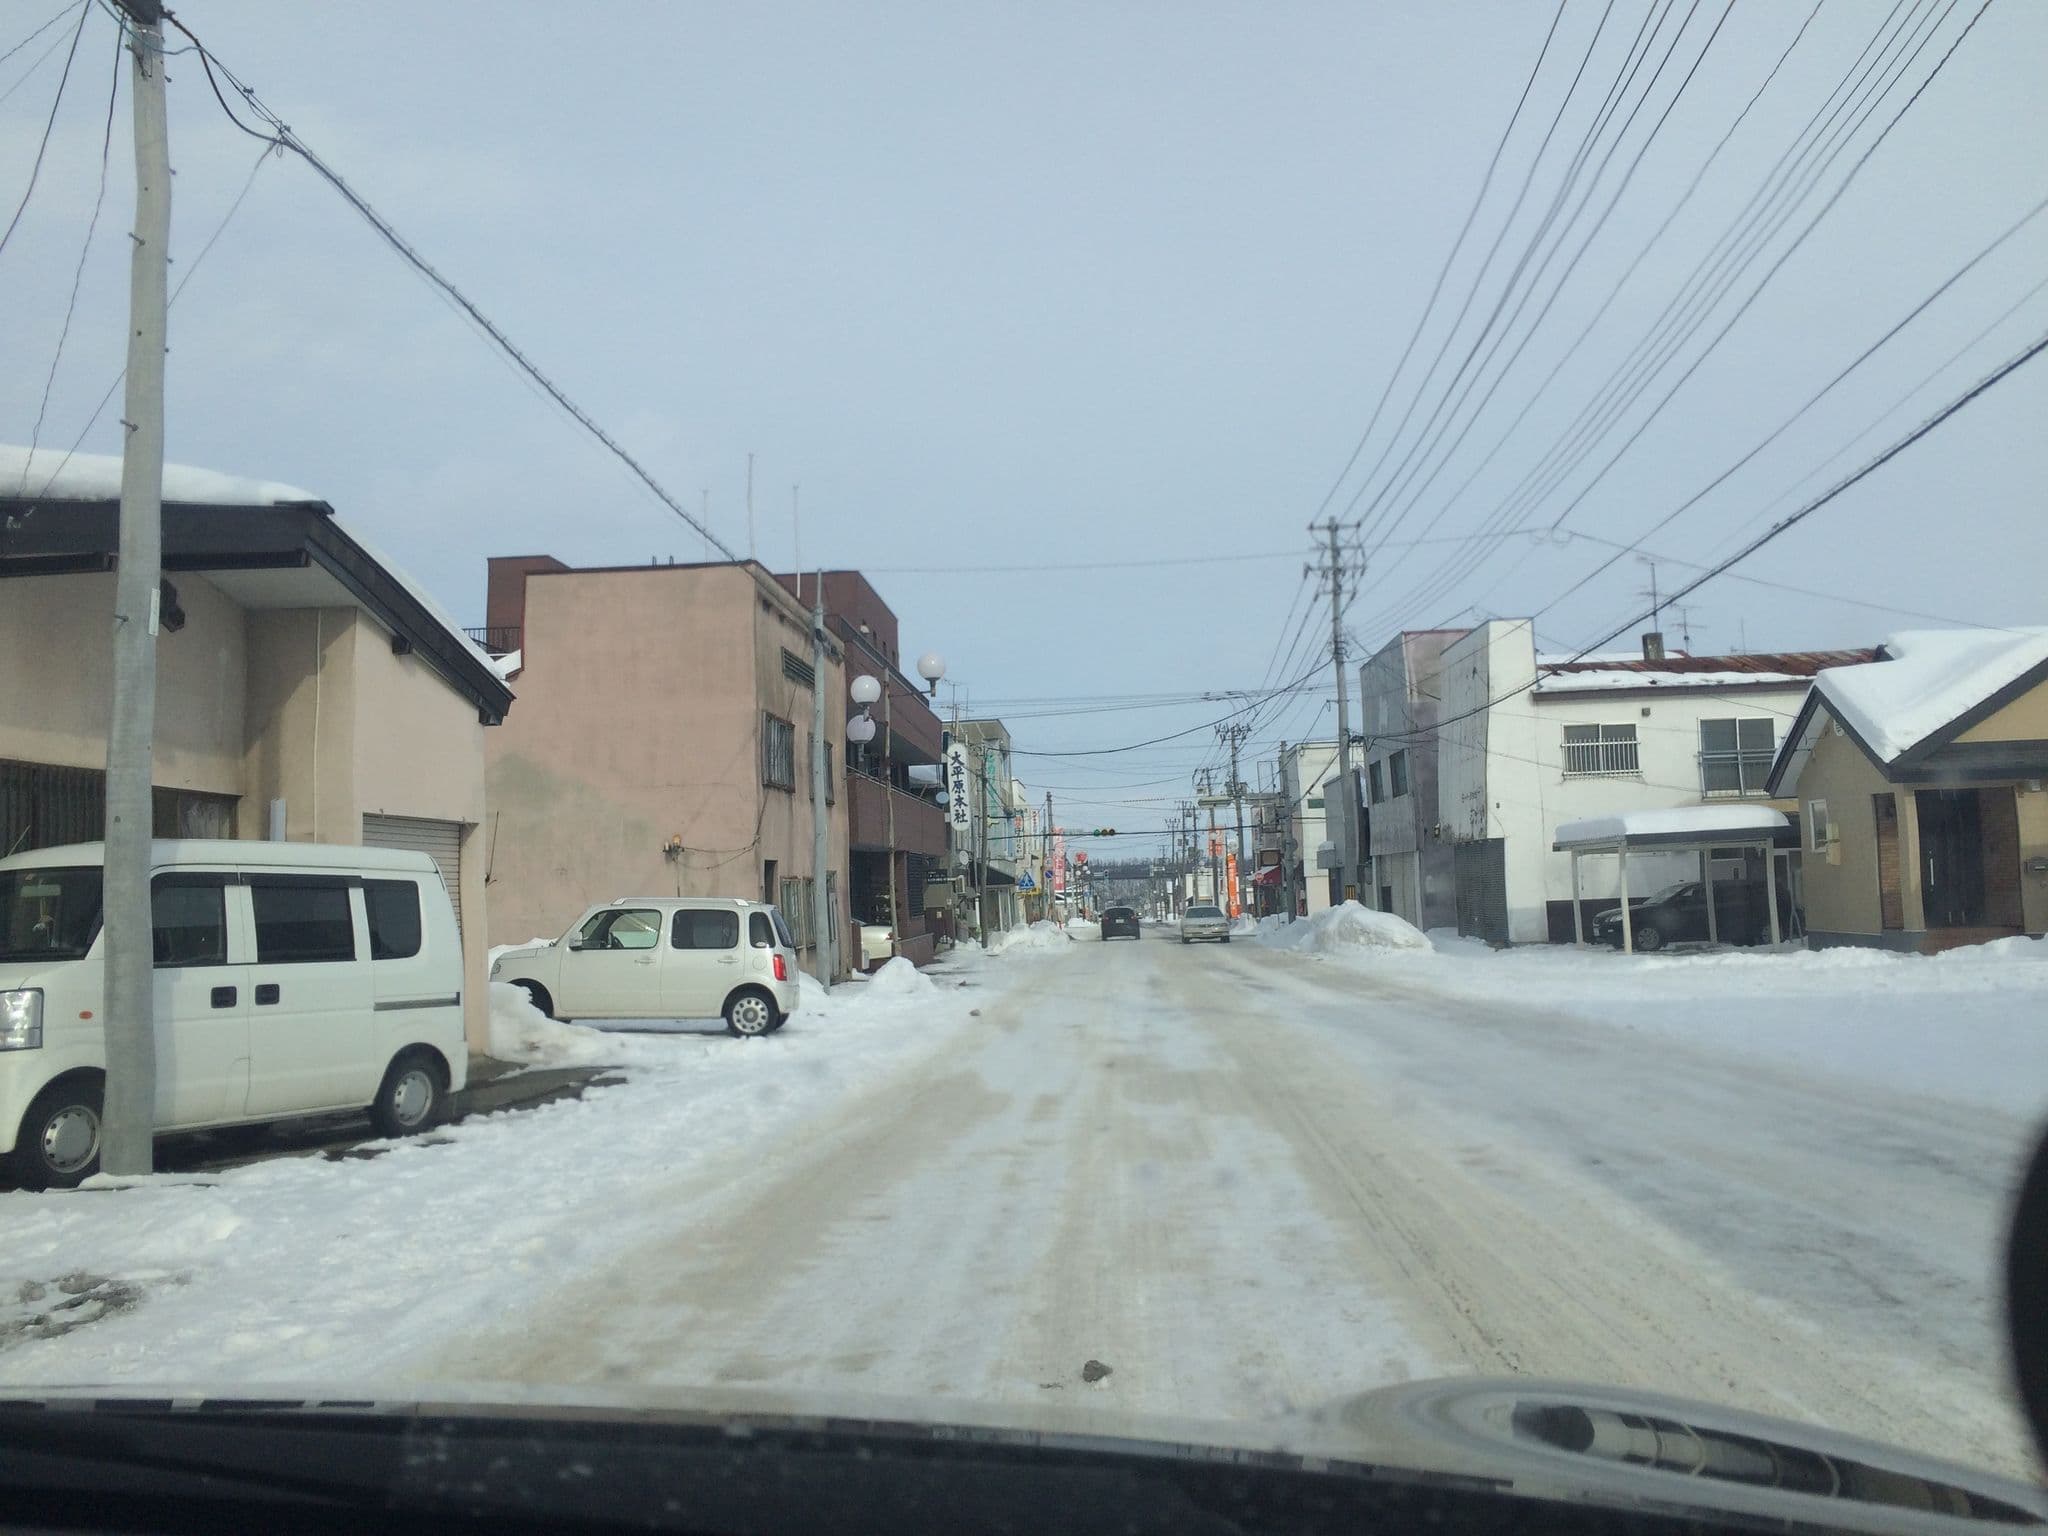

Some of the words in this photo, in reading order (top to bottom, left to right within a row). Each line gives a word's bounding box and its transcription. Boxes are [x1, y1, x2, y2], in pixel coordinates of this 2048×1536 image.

[950, 751, 969, 823] 大平原本社
